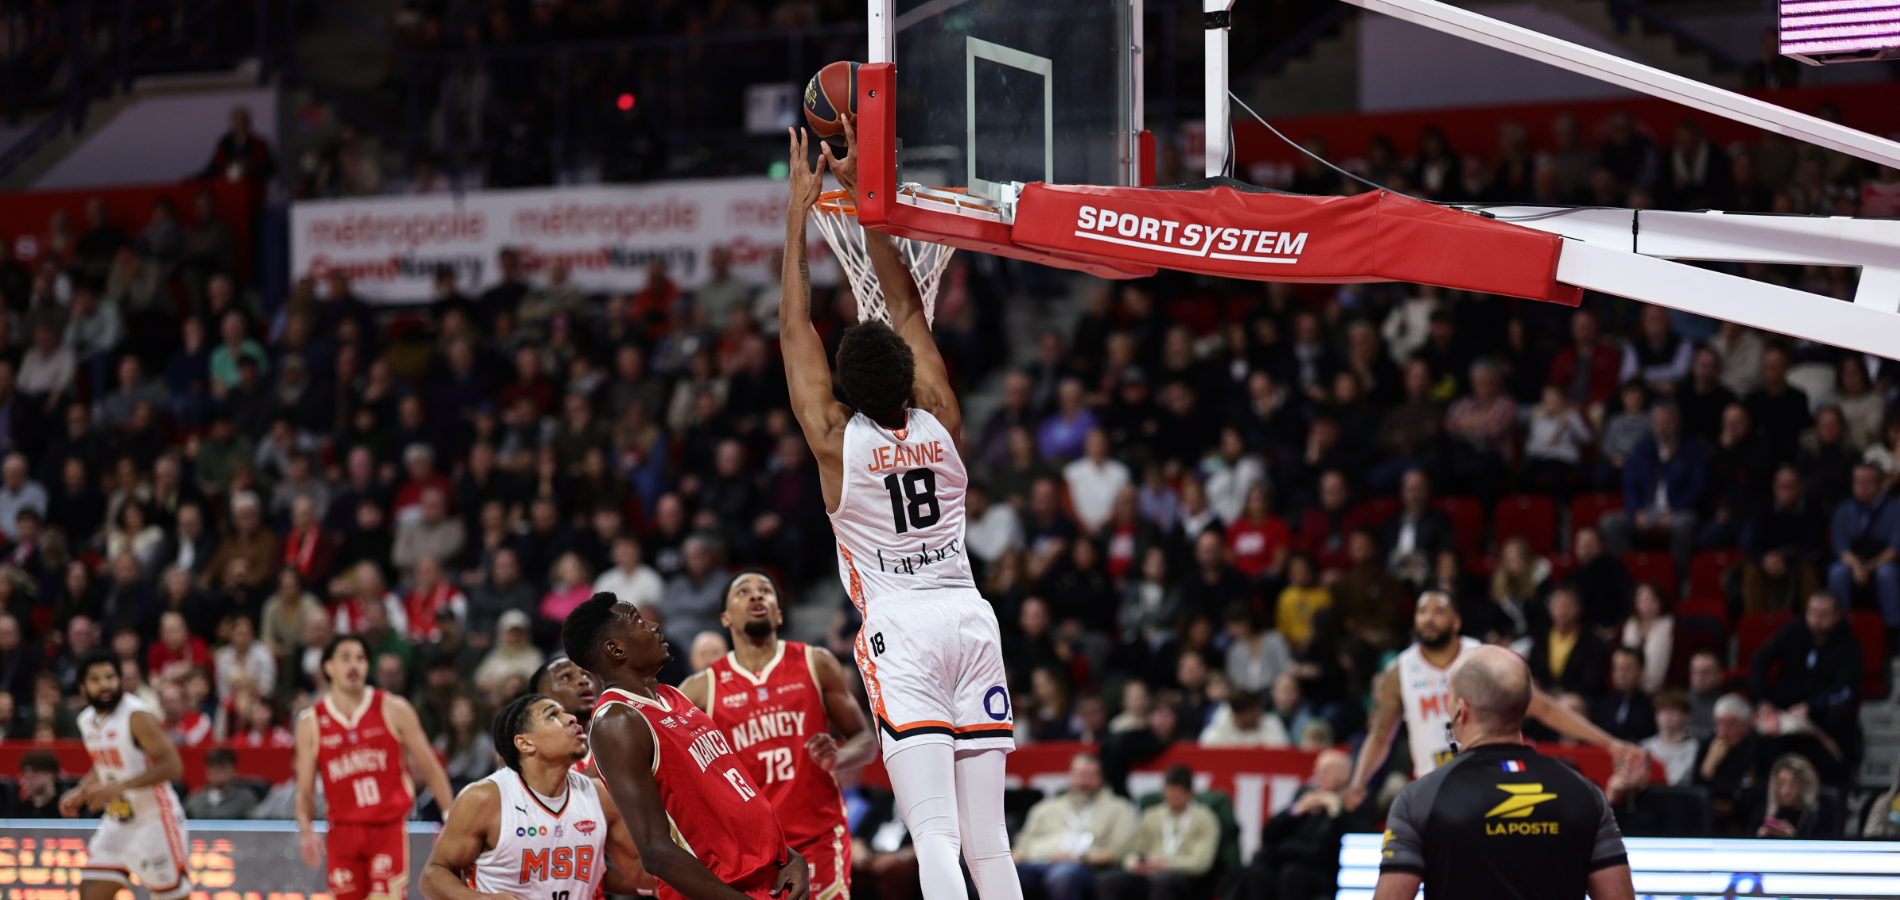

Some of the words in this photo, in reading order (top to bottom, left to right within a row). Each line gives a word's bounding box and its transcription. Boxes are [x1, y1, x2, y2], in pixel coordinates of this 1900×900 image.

[868, 440, 944, 472] JEANNE
[884, 467, 941, 534] 18
[869, 631, 886, 658] 18
[731, 711, 806, 752] NANCY
[327, 749, 388, 784] NANCY
[757, 746, 795, 785] 72
[352, 776, 381, 808] 10
[722, 767, 757, 803] 13
[1485, 822, 1507, 835] LA
[1508, 822, 1559, 835] POSTE
[518, 845, 594, 885] MSB
